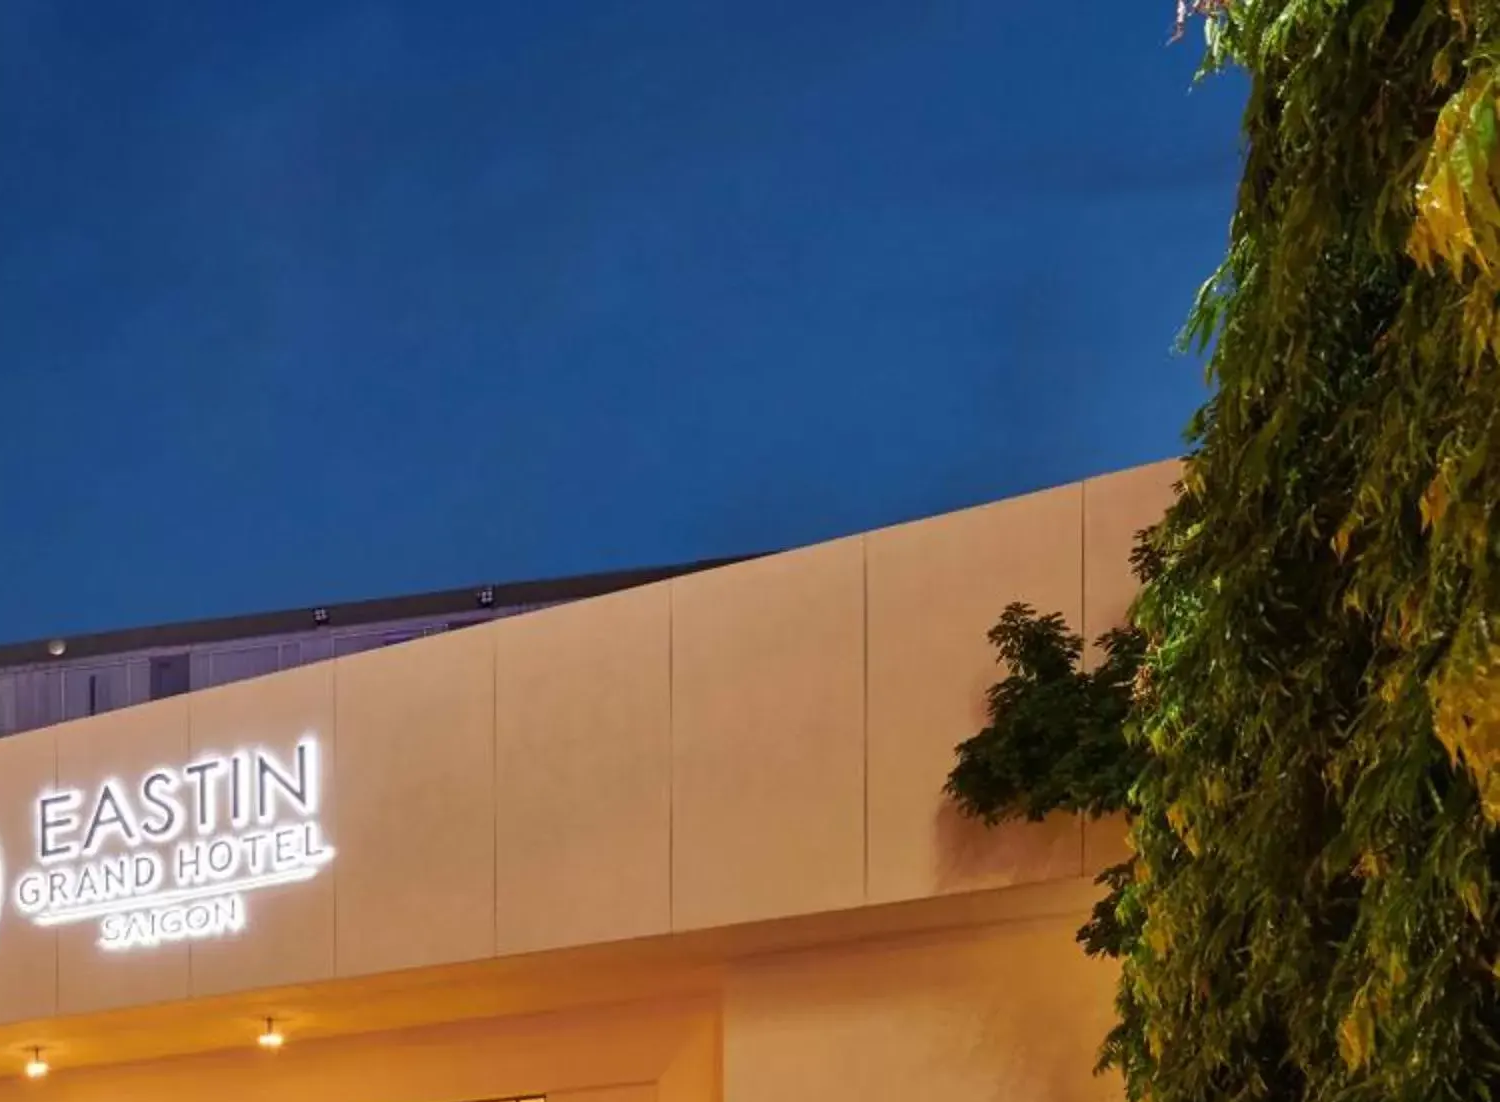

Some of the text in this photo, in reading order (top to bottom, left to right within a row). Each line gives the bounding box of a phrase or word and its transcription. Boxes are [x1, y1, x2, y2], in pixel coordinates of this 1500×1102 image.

[38, 743, 309, 859] EASTIN
[18, 827, 326, 907] GRAND HOTEL
[103, 898, 236, 941] SAIGON
